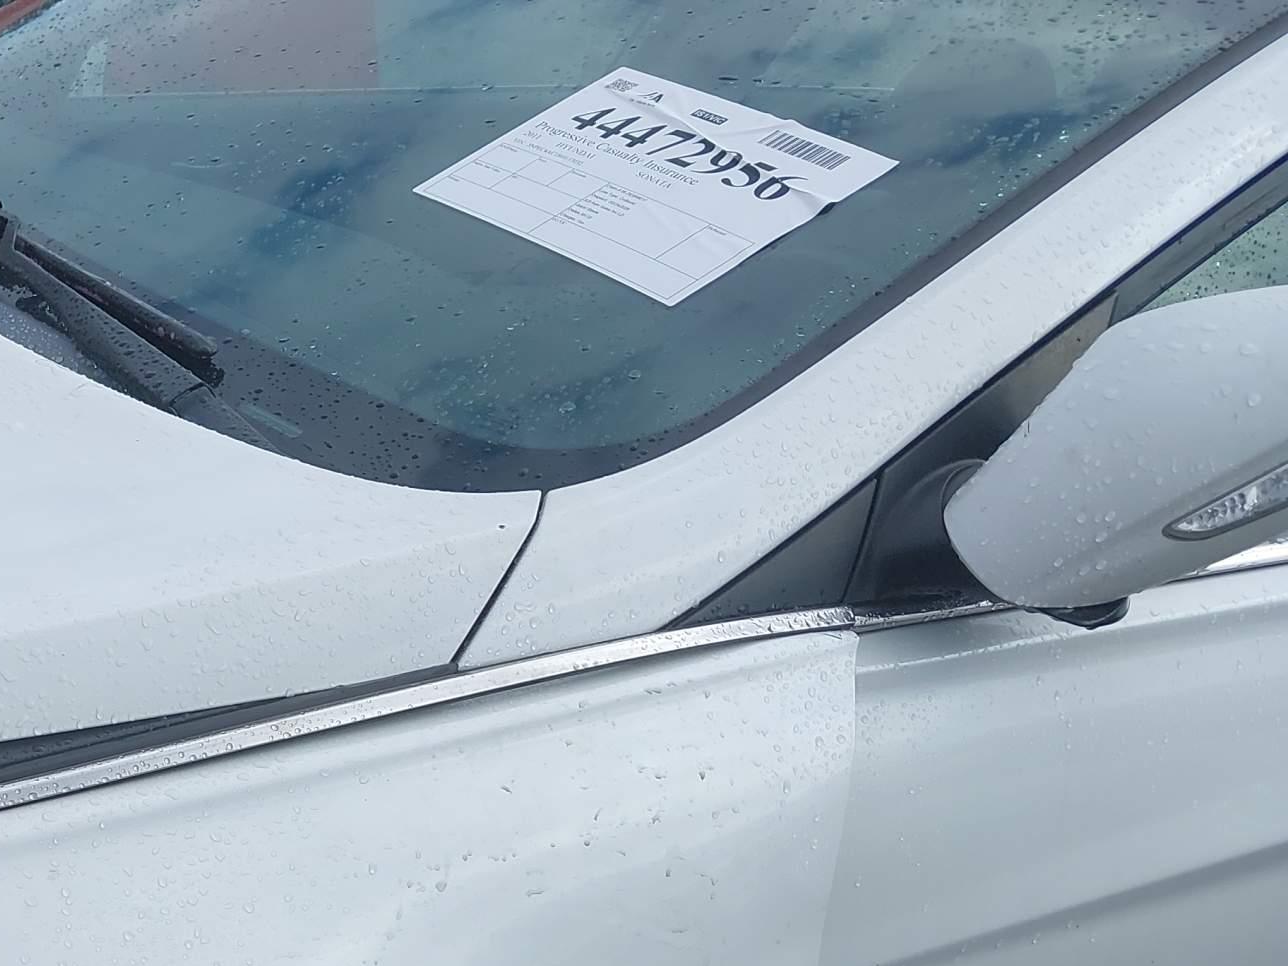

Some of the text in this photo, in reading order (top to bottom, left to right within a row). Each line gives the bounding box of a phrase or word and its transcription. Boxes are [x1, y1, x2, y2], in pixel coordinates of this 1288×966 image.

[535, 120, 596, 147] Progressive
[596, 142, 643, 165] Casualty
[644, 158, 700, 186] Insurance
[555, 141, 596, 159] HYUNDAI
[636, 171, 672, 189] SONATA
[571, 107, 808, 200] 44472956
